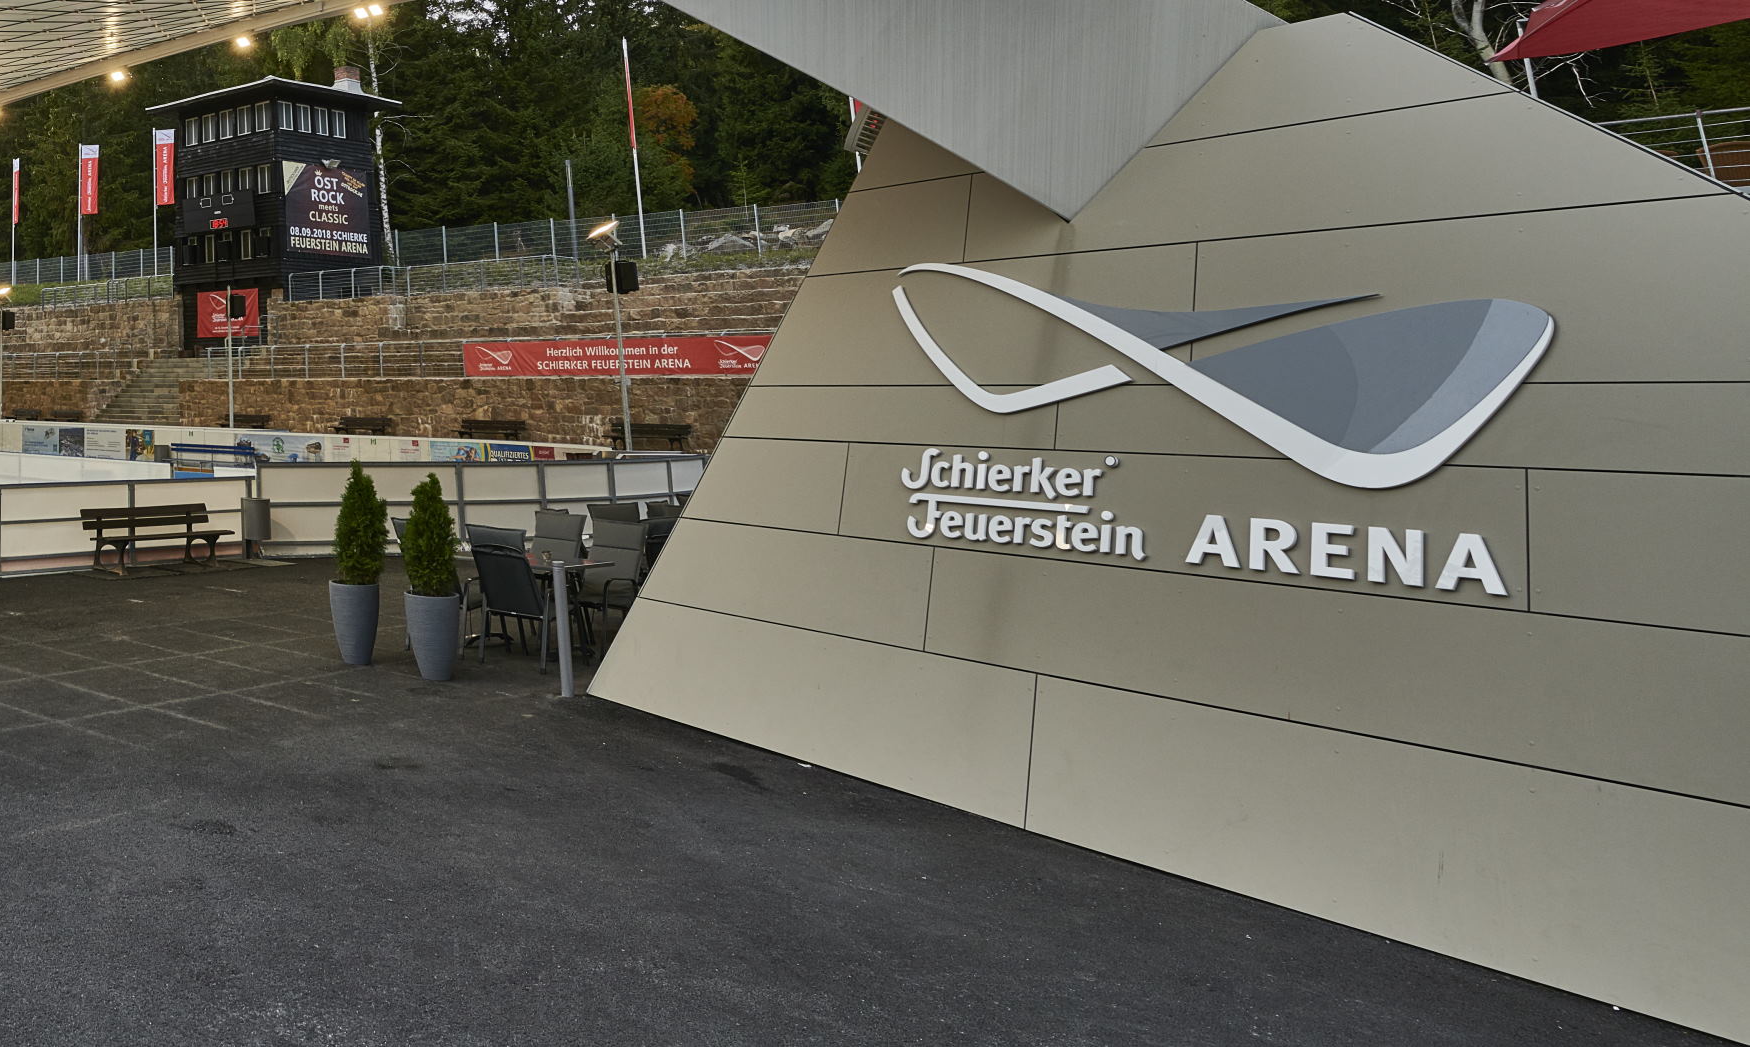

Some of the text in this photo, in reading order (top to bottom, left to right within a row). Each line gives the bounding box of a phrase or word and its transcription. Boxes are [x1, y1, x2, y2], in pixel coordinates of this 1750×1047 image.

[314, 176, 338, 190] OST
[310, 189, 345, 205] ROCK
[318, 204, 338, 212] meets
[309, 211, 349, 225] CLASSIC
[290, 226, 368, 243] 08.09.2018 SCHIERKE
[290, 236, 369, 254] FEUERSTEIN ARENA
[546, 347, 583, 357] Herzlich
[649, 345, 658, 355] in
[661, 344, 679, 355] der
[537, 360, 589, 370] SCHIERKER
[654, 358, 691, 368] ARENA
[490, 450, 529, 460] QUALIFIZIERTES
[900, 446, 1105, 500] Schierker
[1184, 512, 1509, 597] ARENA
